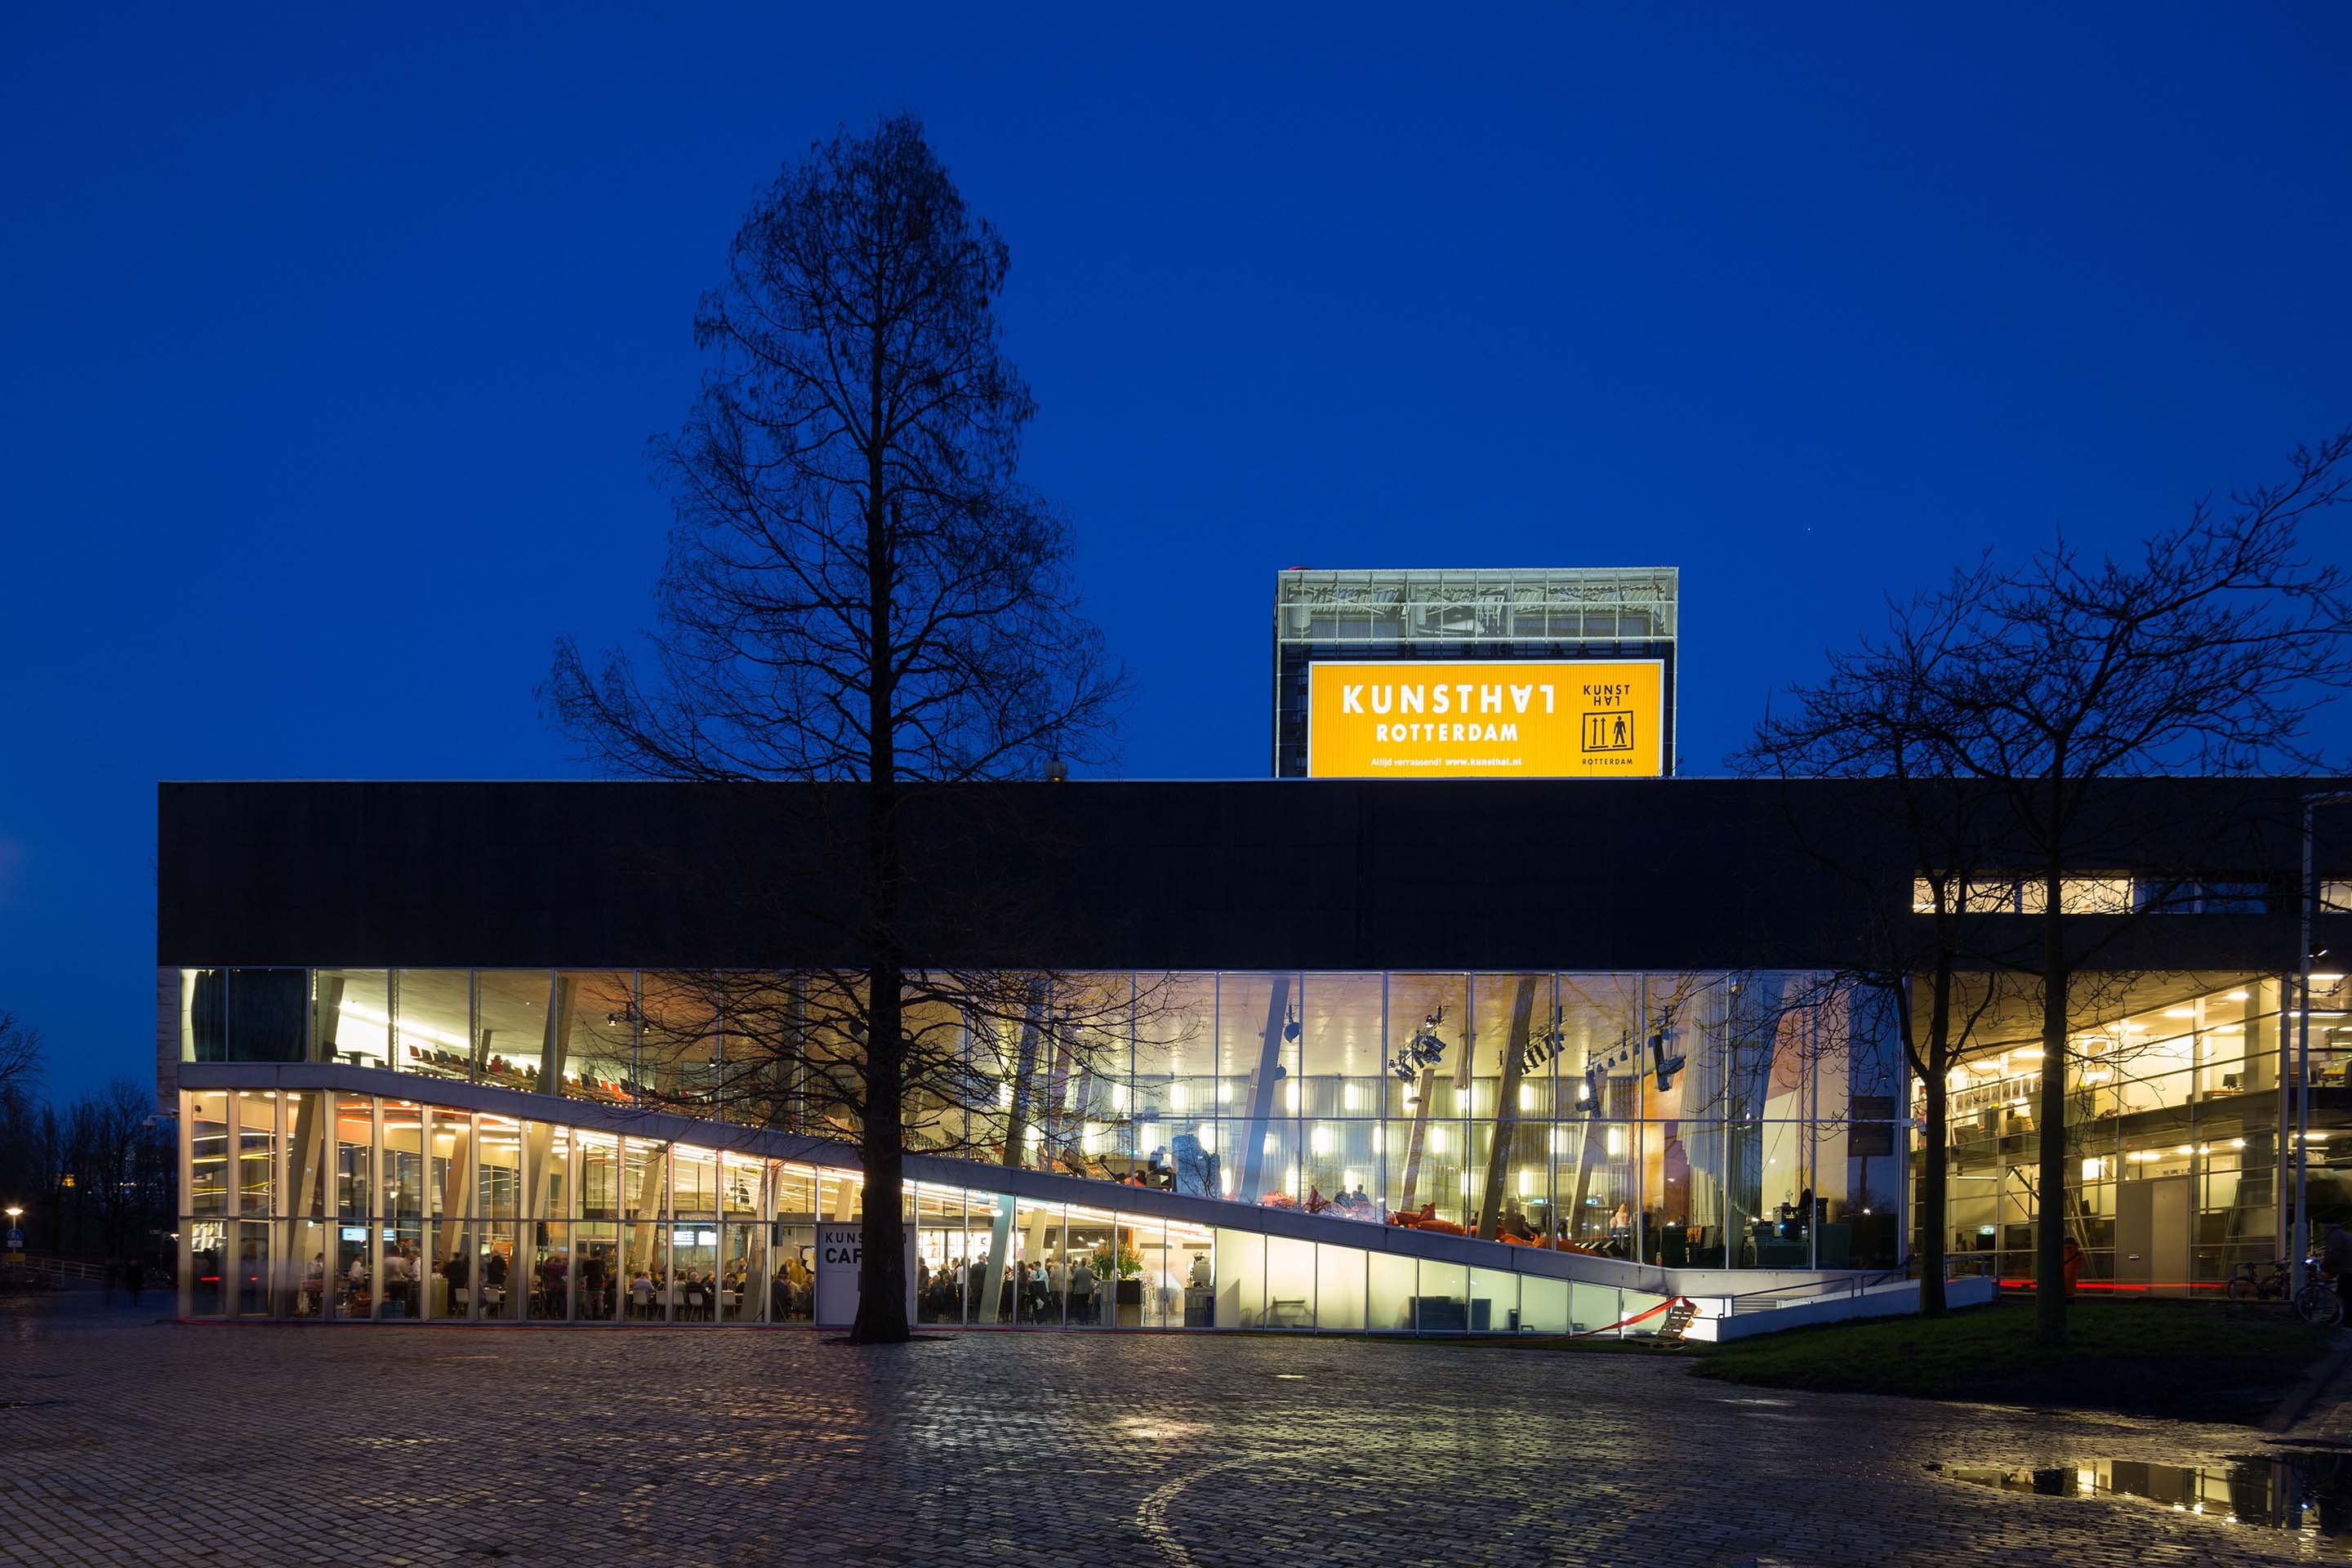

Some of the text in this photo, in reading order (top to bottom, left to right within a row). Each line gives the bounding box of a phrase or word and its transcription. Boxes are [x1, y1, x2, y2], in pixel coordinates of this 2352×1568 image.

[1583, 684, 1631, 696] KUNST
[1375, 723, 1519, 742] ROTTERDAM
[1370, 757, 1523, 768] Altijd verrassend! www.kunsthal.nl
[825, 1248, 863, 1263] CAF
